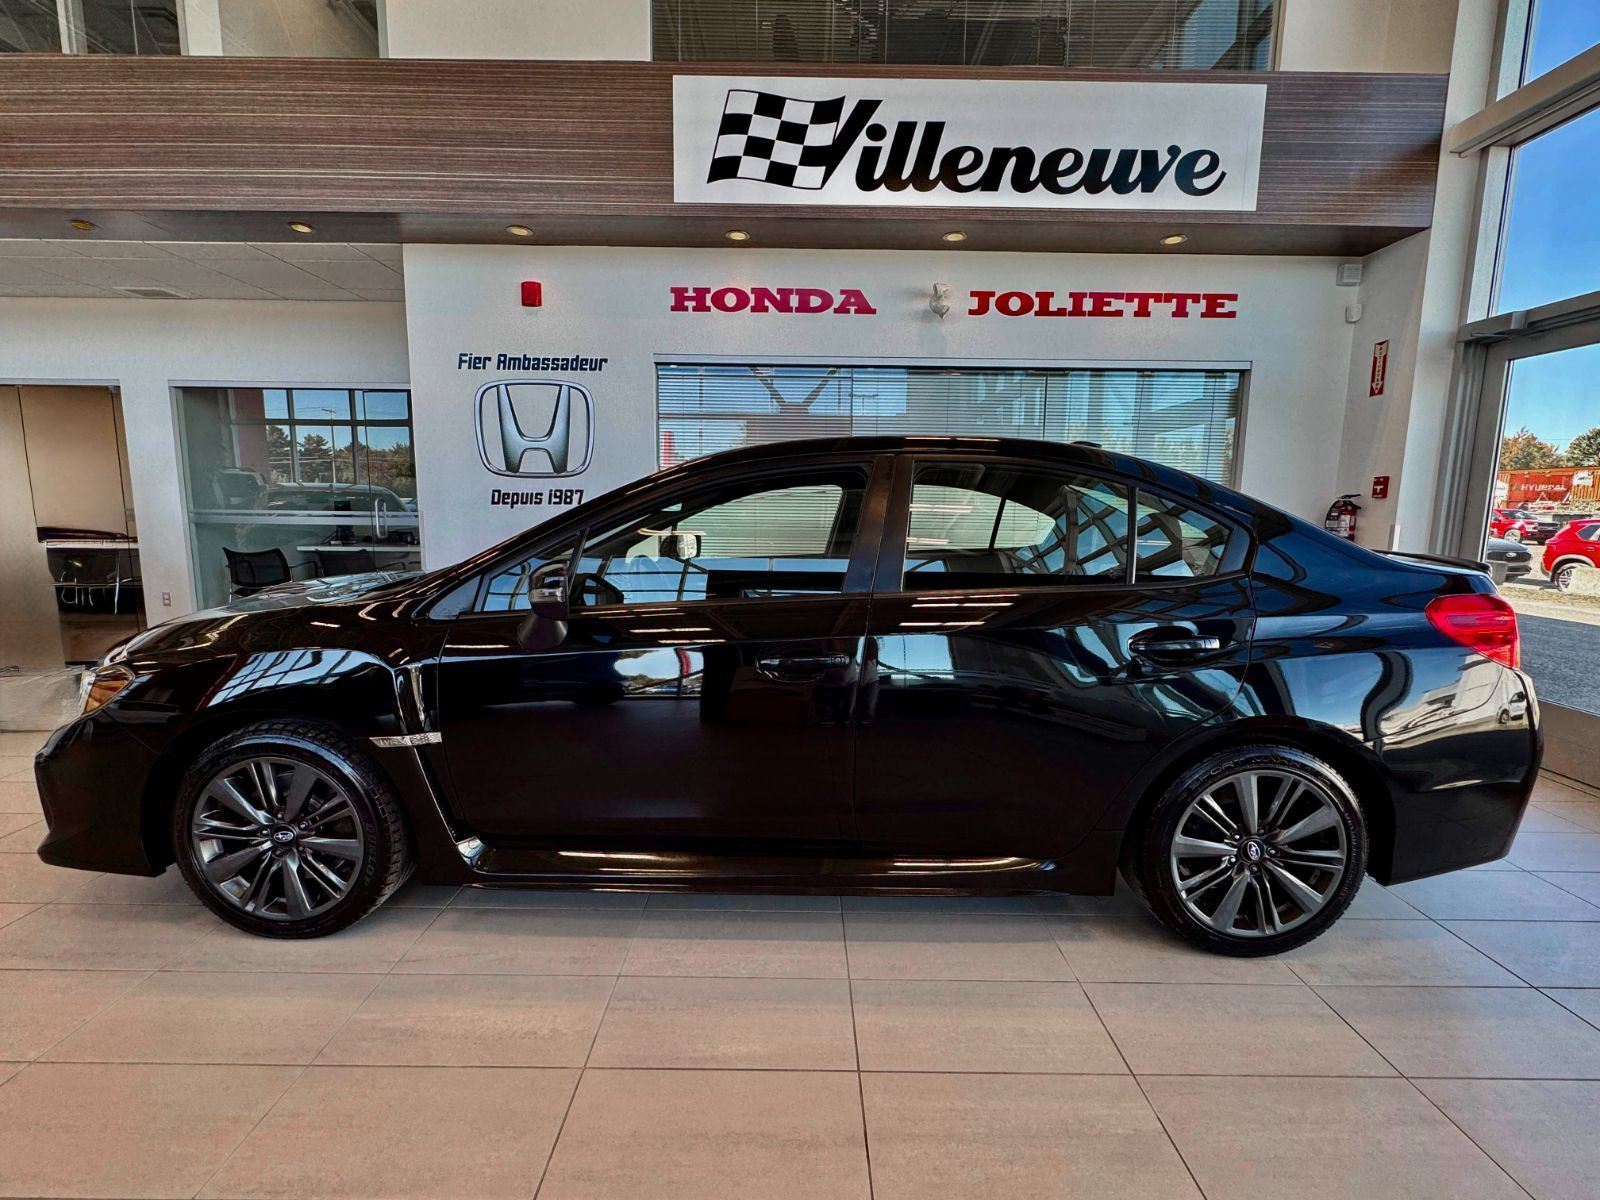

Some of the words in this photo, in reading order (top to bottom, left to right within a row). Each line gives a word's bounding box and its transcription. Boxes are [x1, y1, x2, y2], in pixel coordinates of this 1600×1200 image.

[800, 95, 1227, 197] Villeneuve
[670, 287, 877, 315] HONDA
[968, 290, 1238, 318] JOLIETTE
[457, 352, 492, 370] Fier
[496, 353, 608, 372] Ambassadeur
[490, 489, 544, 510] Depuis
